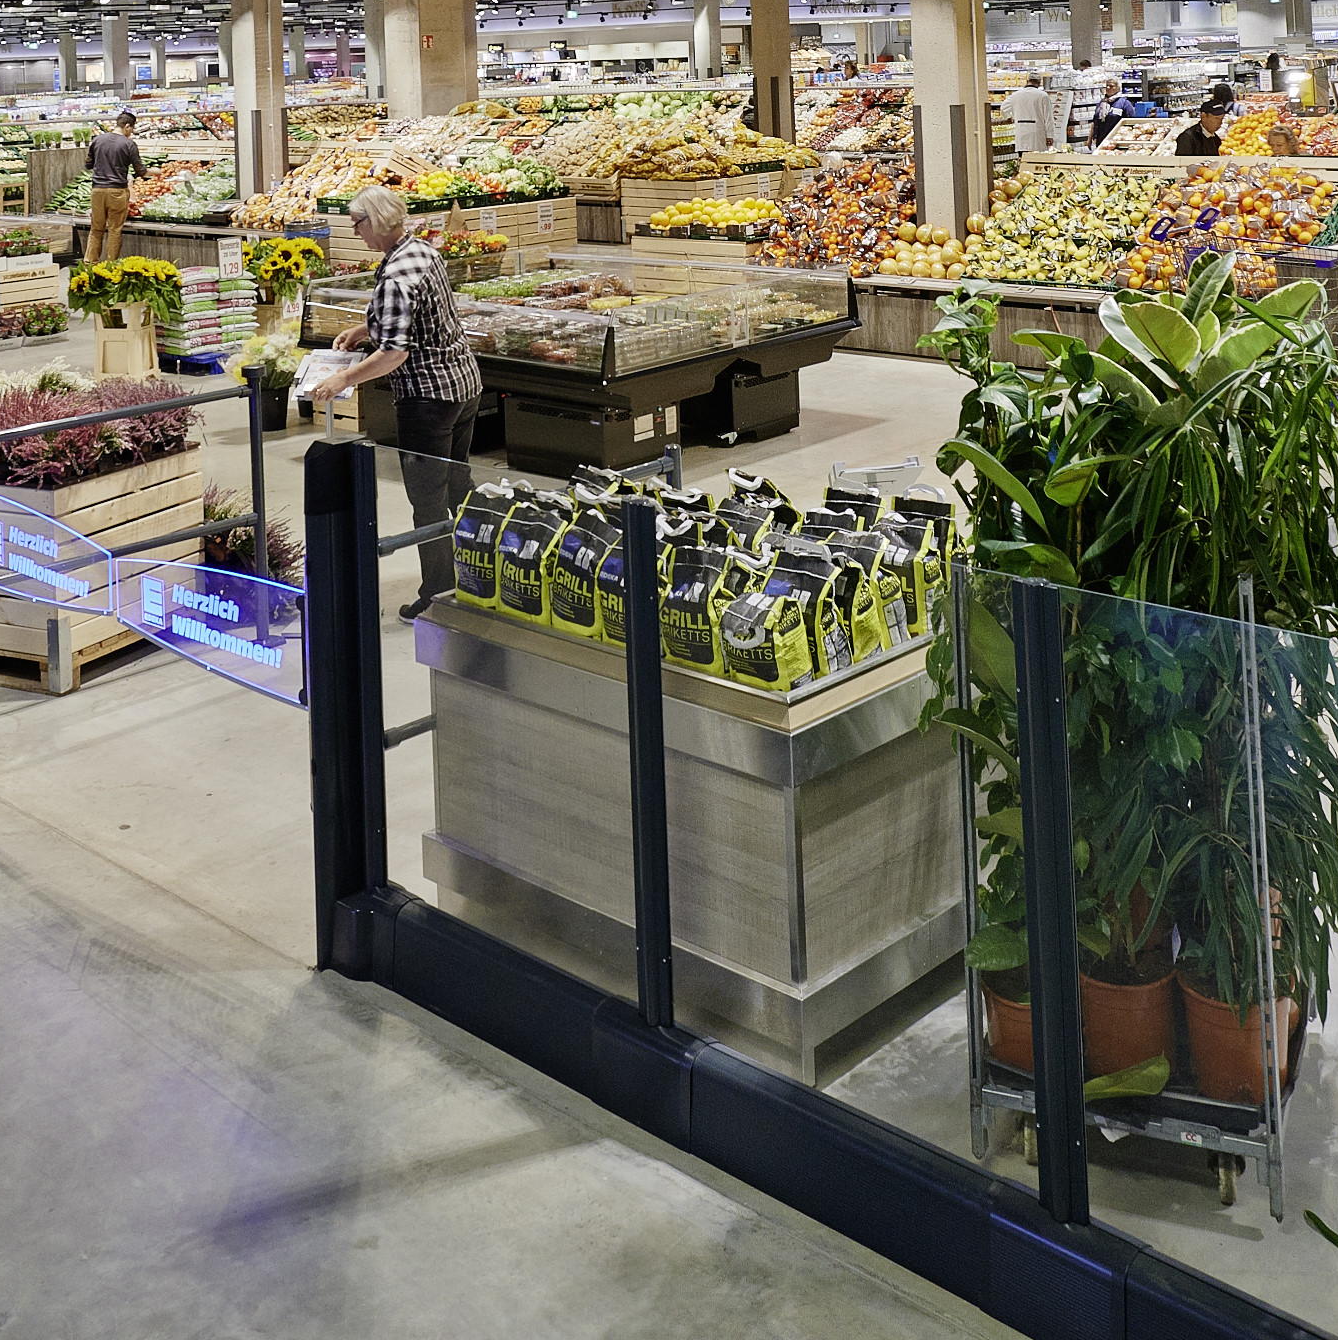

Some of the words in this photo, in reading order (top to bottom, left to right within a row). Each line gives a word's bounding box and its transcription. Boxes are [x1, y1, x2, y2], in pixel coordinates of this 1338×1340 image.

[223, 262, 239, 276] 1,29
[8, 526, 59, 558] Herzlich
[454, 546, 494, 569] GRILL
[8, 552, 90, 598] Willkommen!
[555, 567, 592, 597] GRILL
[171, 583, 240, 623] Herzlich
[553, 583, 593, 607] BRIKETTS
[599, 590, 626, 613] GRI
[601, 609, 626, 625] BRIKE
[659, 607, 710, 630] GRILL
[171, 613, 283, 669] Willkommen!
[659, 624, 710, 643] BRIKETTS
